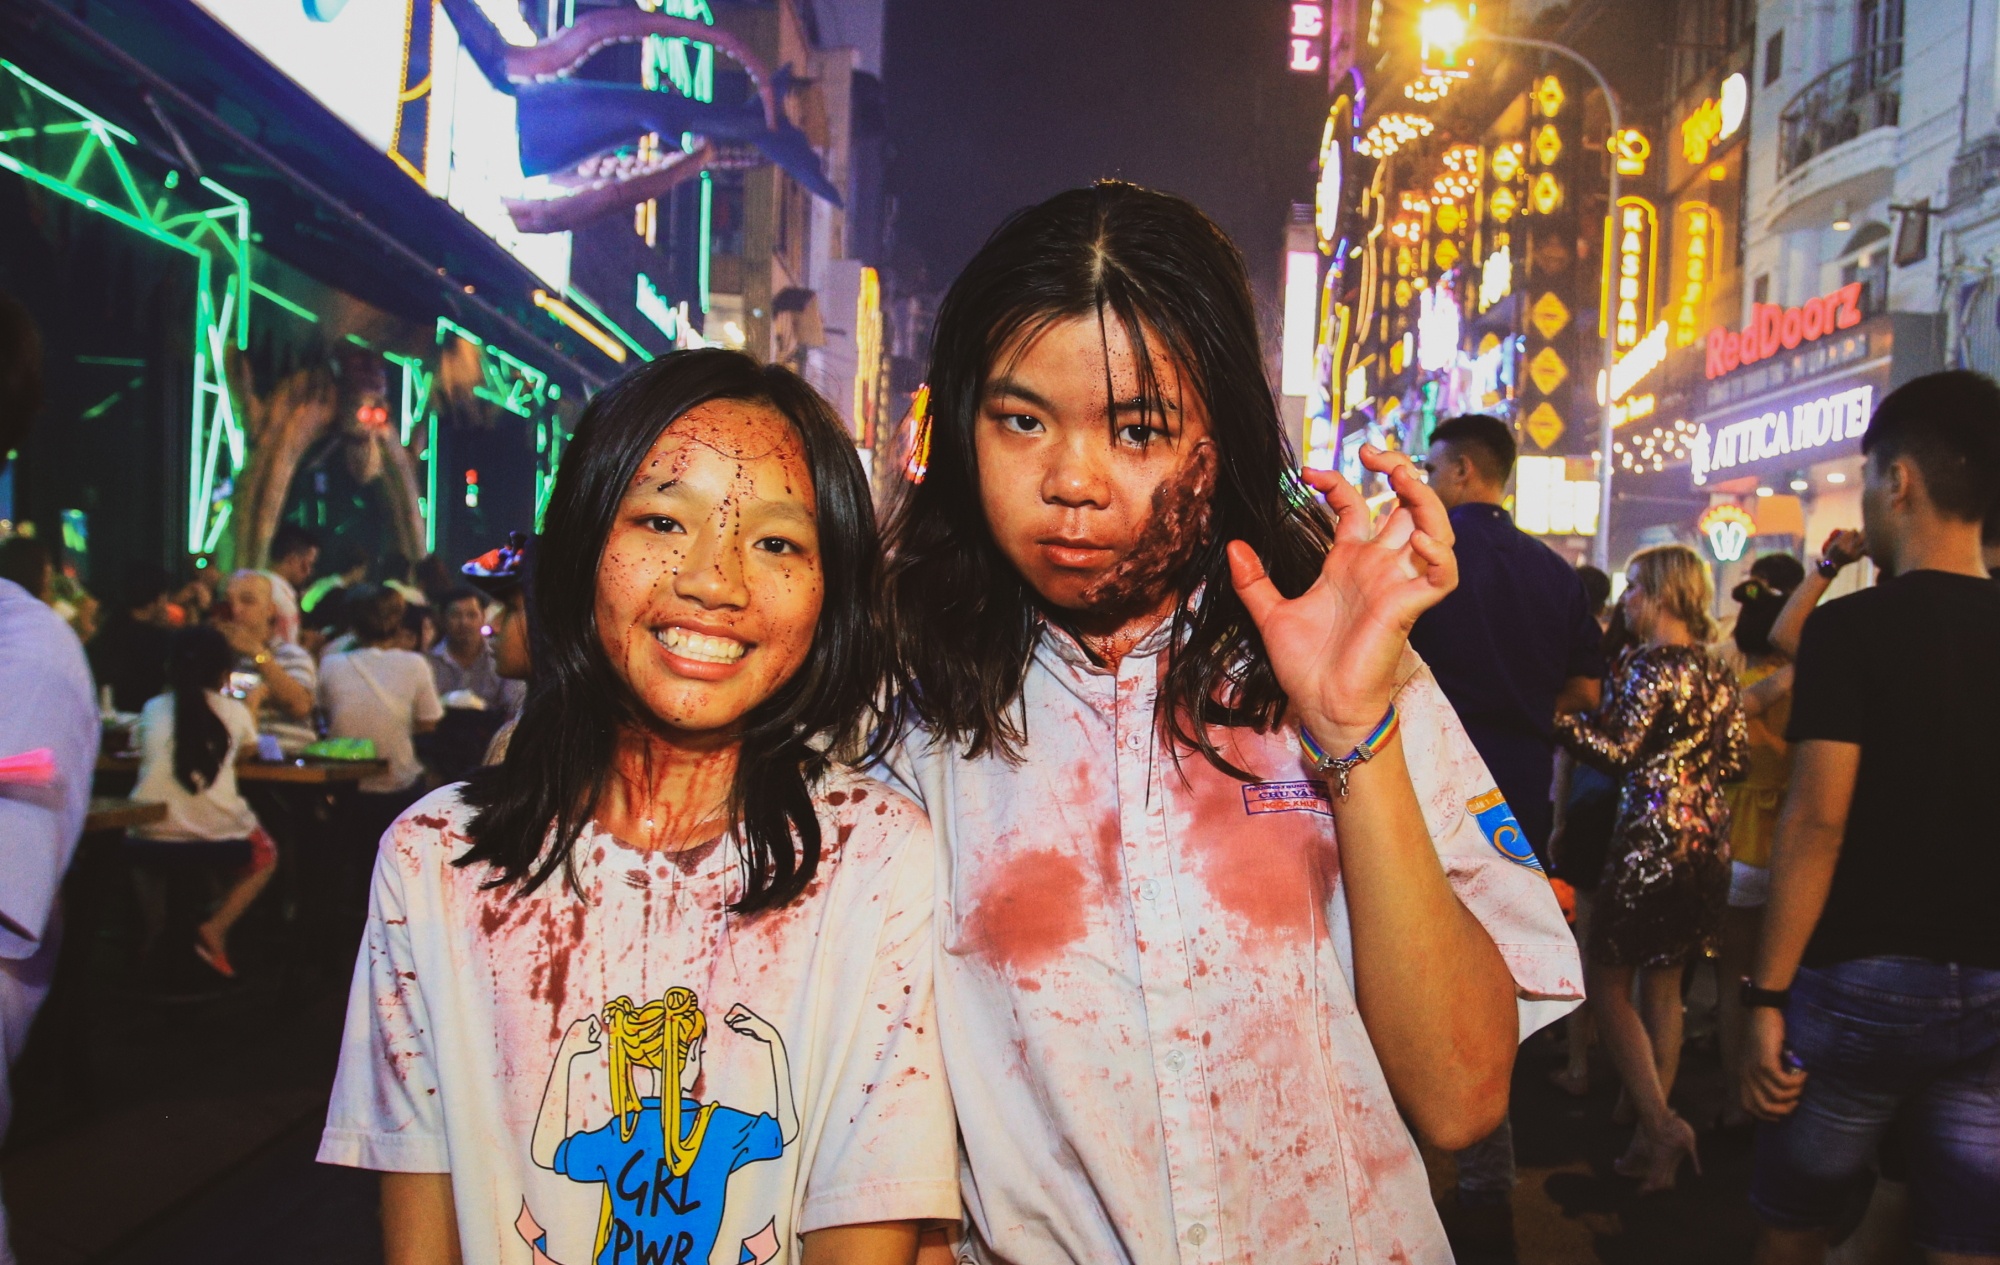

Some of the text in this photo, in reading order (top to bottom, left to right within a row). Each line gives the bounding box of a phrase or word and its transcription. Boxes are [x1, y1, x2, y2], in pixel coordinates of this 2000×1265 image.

[1289, 0, 1323, 72] EL
[1616, 206, 1644, 347] KASBAH
[1705, 281, 1863, 380] RedDoorz
[1711, 409, 1791, 471] ATTICA
[616, 1149, 702, 1218] GRL
[612, 1218, 694, 1265] PWR
